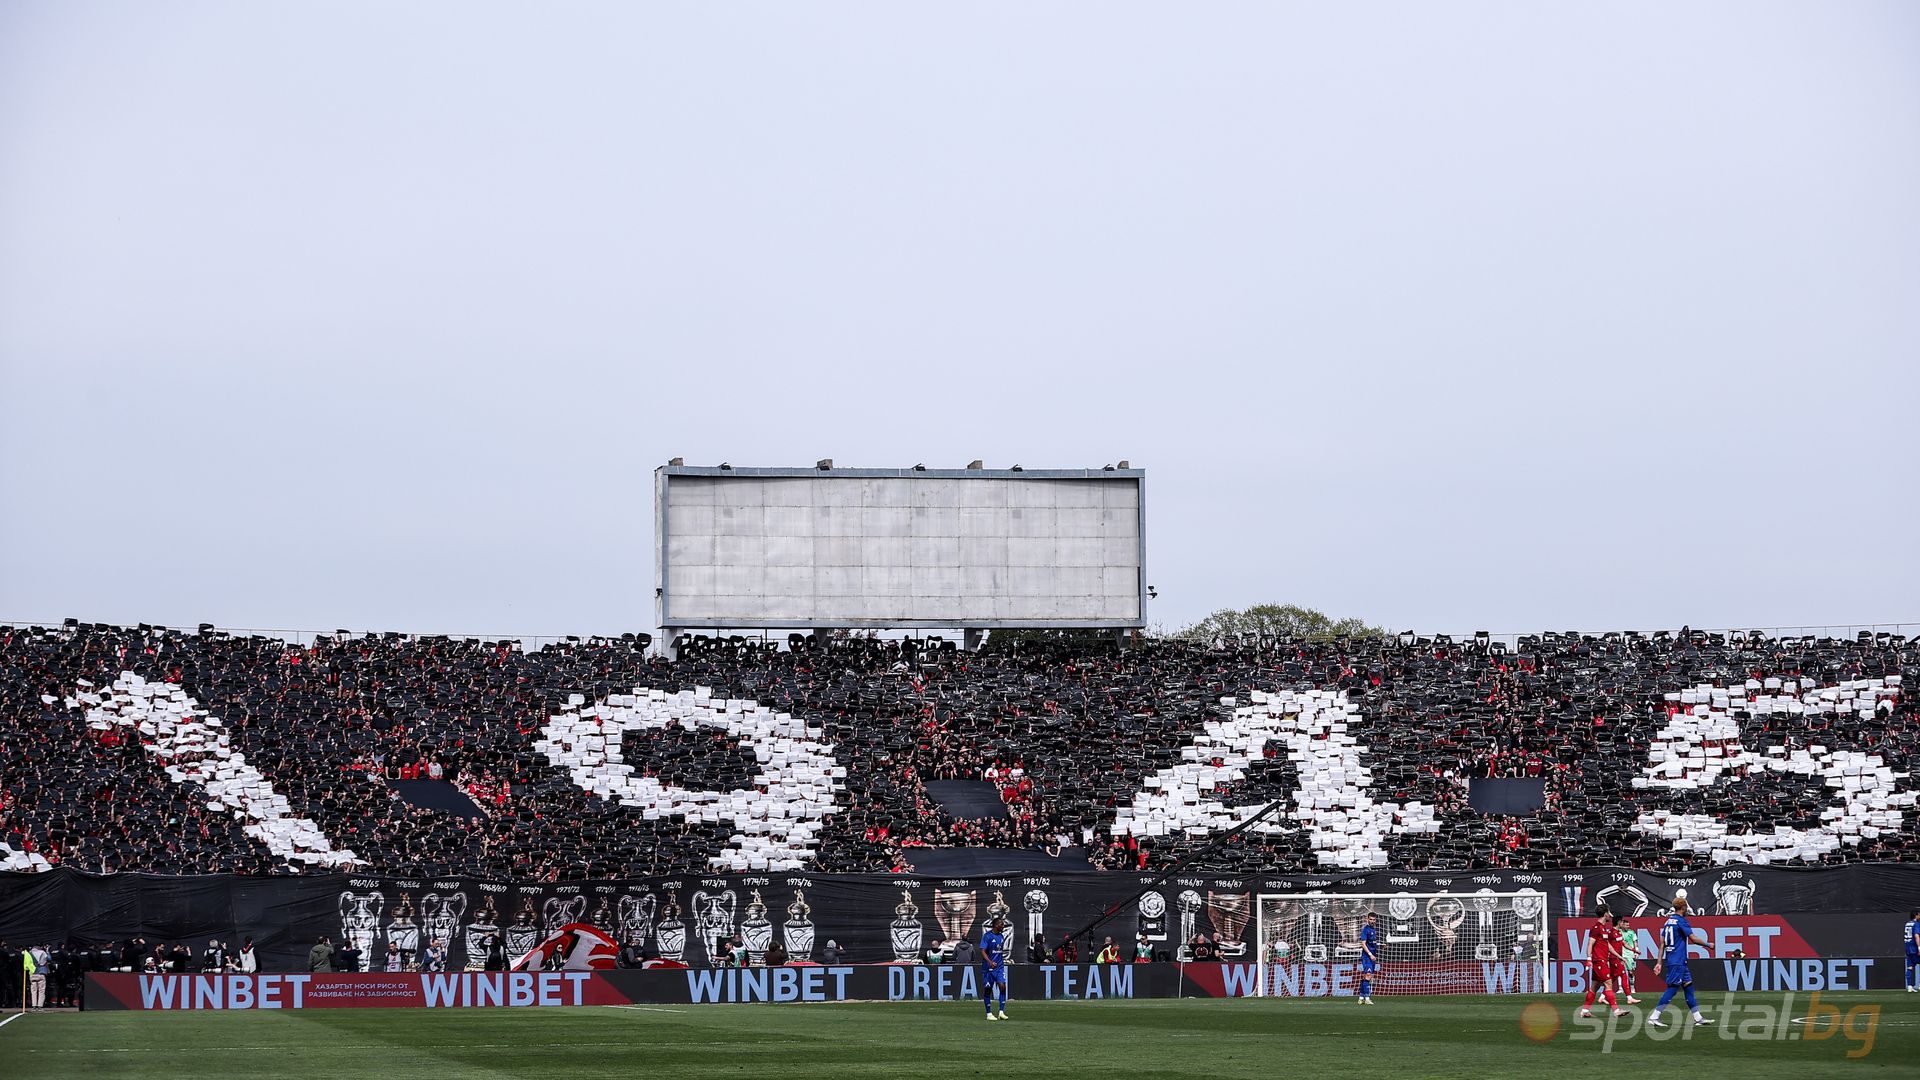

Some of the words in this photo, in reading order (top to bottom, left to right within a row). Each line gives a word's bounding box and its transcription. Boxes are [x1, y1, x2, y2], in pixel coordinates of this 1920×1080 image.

[1023, 876, 1051, 886] 1981/82
[1472, 873, 1502, 885] 1989/90
[1512, 873, 1543, 885] 1989/90
[1562, 874, 1584, 883] 1994
[1611, 873, 1636, 884] 1994
[1722, 870, 1743, 881] 2008
[700, 878, 727, 889] 1973/74
[742, 876, 770, 887] 1974/75
[786, 876, 812, 888] 1975/76
[892, 880, 920, 889] 1979/80
[942, 879, 969, 888] 1980/81
[985, 878, 1011, 888] 1980/81
[1176, 878, 1204, 888] 1986/87
[1214, 879, 1243, 889] 1986/87
[1264, 880, 1292, 889] 1987/88
[1389, 876, 1419, 887] 1988/89
[1434, 878, 1452, 886] 1989
[1667, 877, 1697, 887] 1998/99
[478, 883, 508, 893] 1968/69
[519, 886, 543, 896] 1970/71
[1664, 926, 1675, 946] 11
[1724, 959, 1874, 991] WINBET
[686, 967, 854, 1003] WINBET
[1039, 964, 1133, 1000] TEAM
[139, 974, 311, 1009] WINBET
[420, 972, 591, 1007] WINBET
